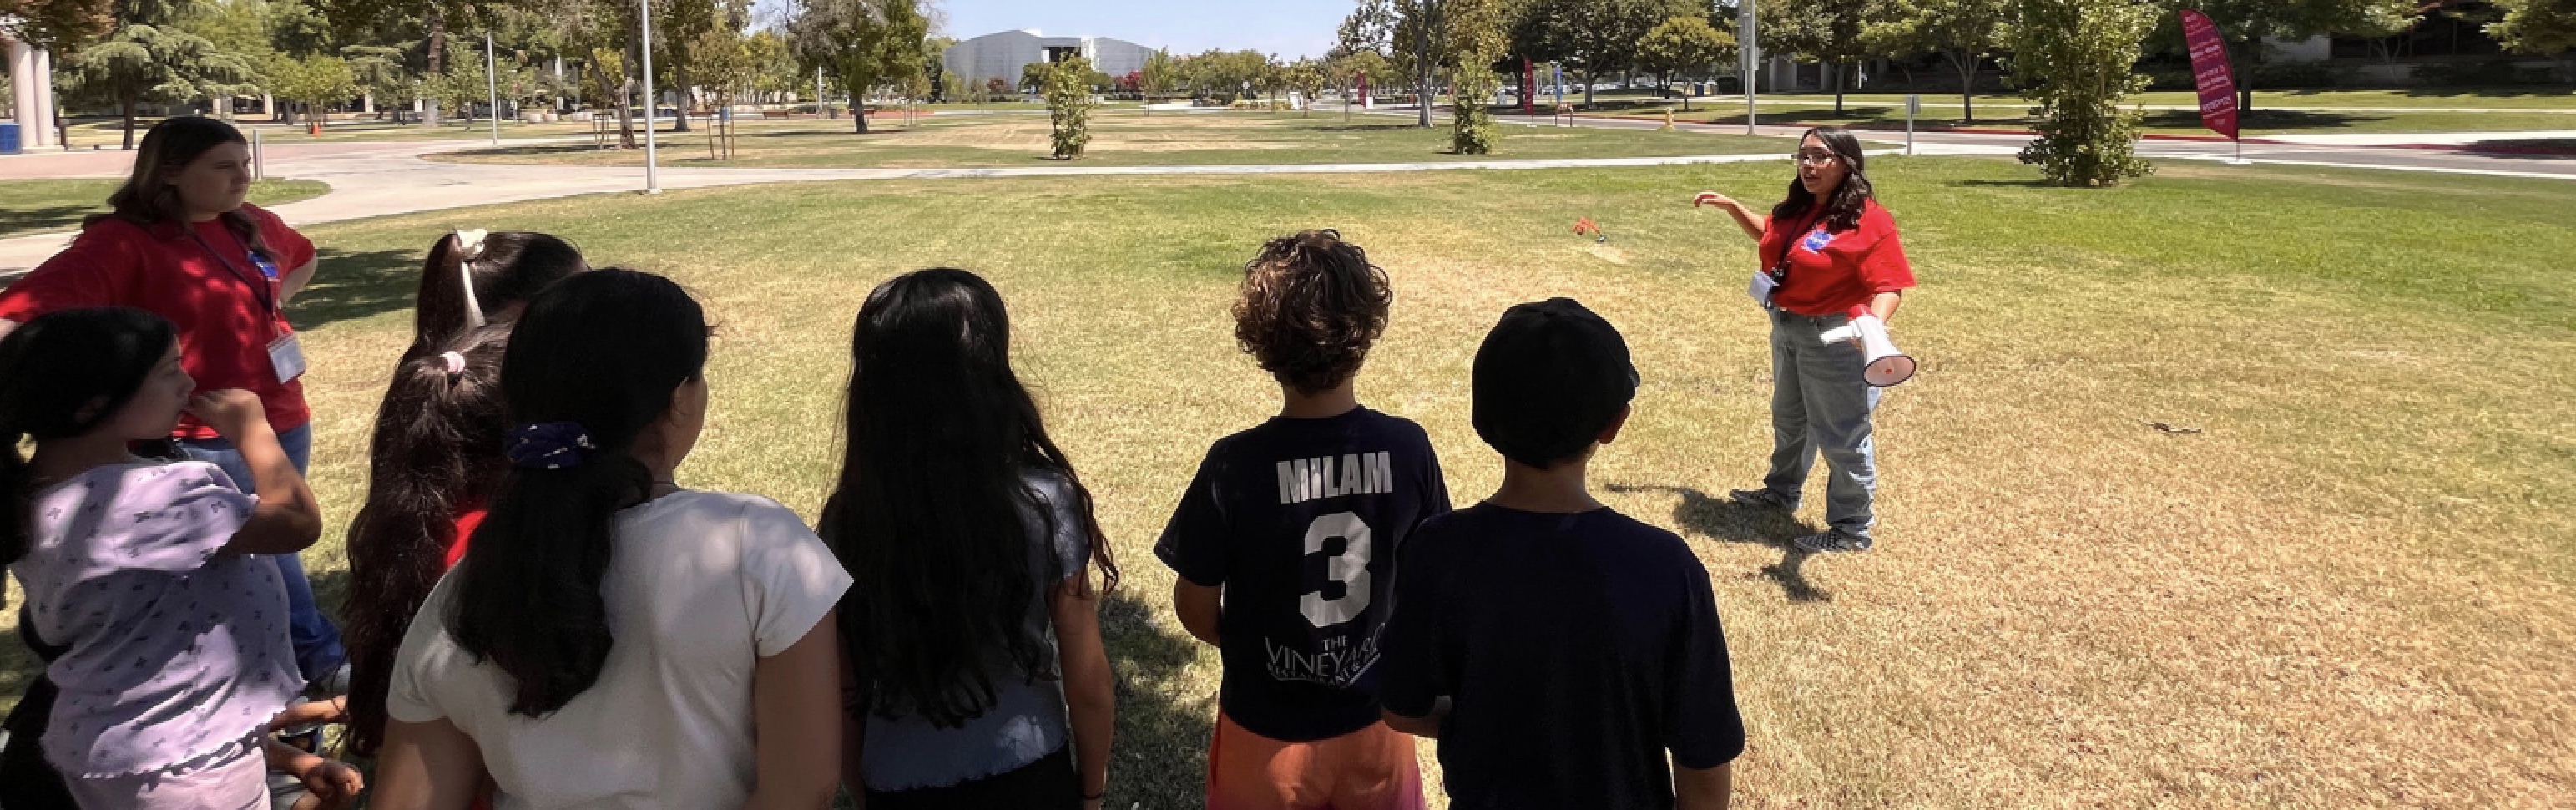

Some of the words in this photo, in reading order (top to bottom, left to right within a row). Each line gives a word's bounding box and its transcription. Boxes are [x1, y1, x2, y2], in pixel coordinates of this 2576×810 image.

[1276, 451, 1392, 504] MILAM
[1299, 511, 1372, 629] 3
[1322, 635, 1348, 651] THE
